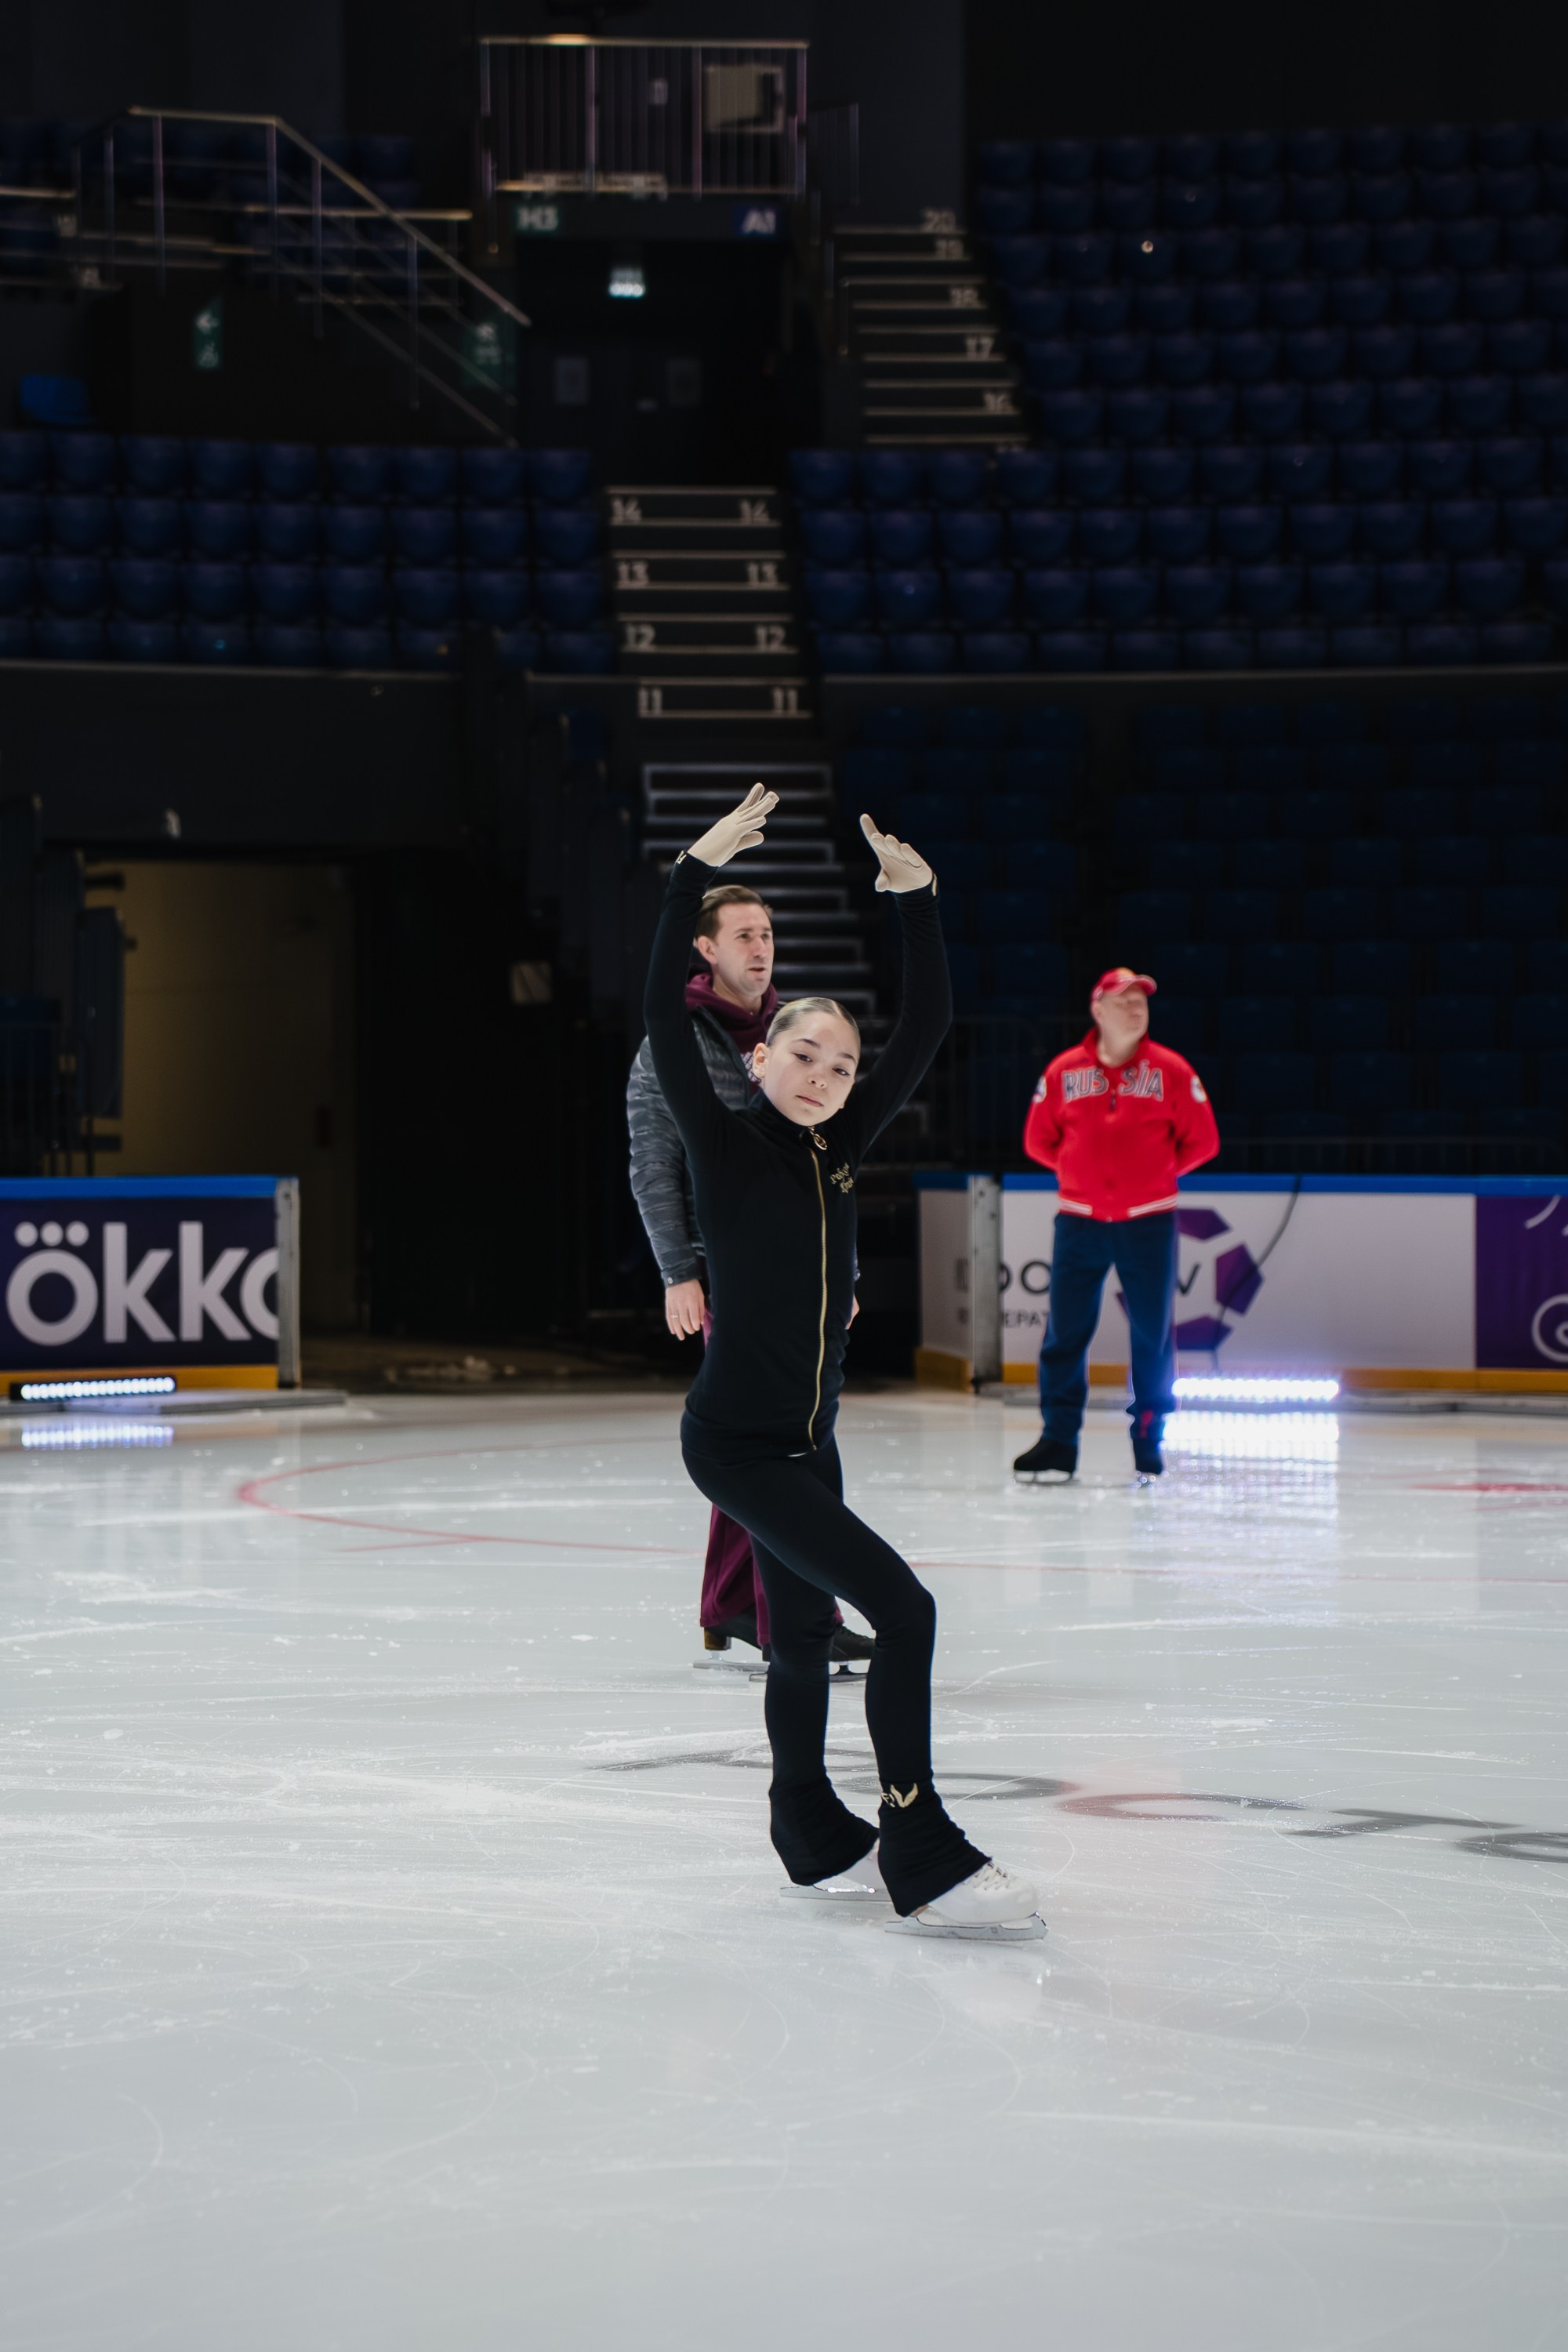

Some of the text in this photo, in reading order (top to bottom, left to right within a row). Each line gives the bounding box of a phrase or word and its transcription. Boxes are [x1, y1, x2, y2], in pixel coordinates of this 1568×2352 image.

[965, 336, 996, 361] 17
[611, 496, 642, 524] 14
[739, 499, 770, 526] 14
[617, 560, 649, 586] 13
[746, 561, 779, 588] 13
[624, 622, 656, 651] 12
[755, 624, 786, 652] 12
[638, 686, 663, 717] 11
[771, 686, 799, 716] 11
